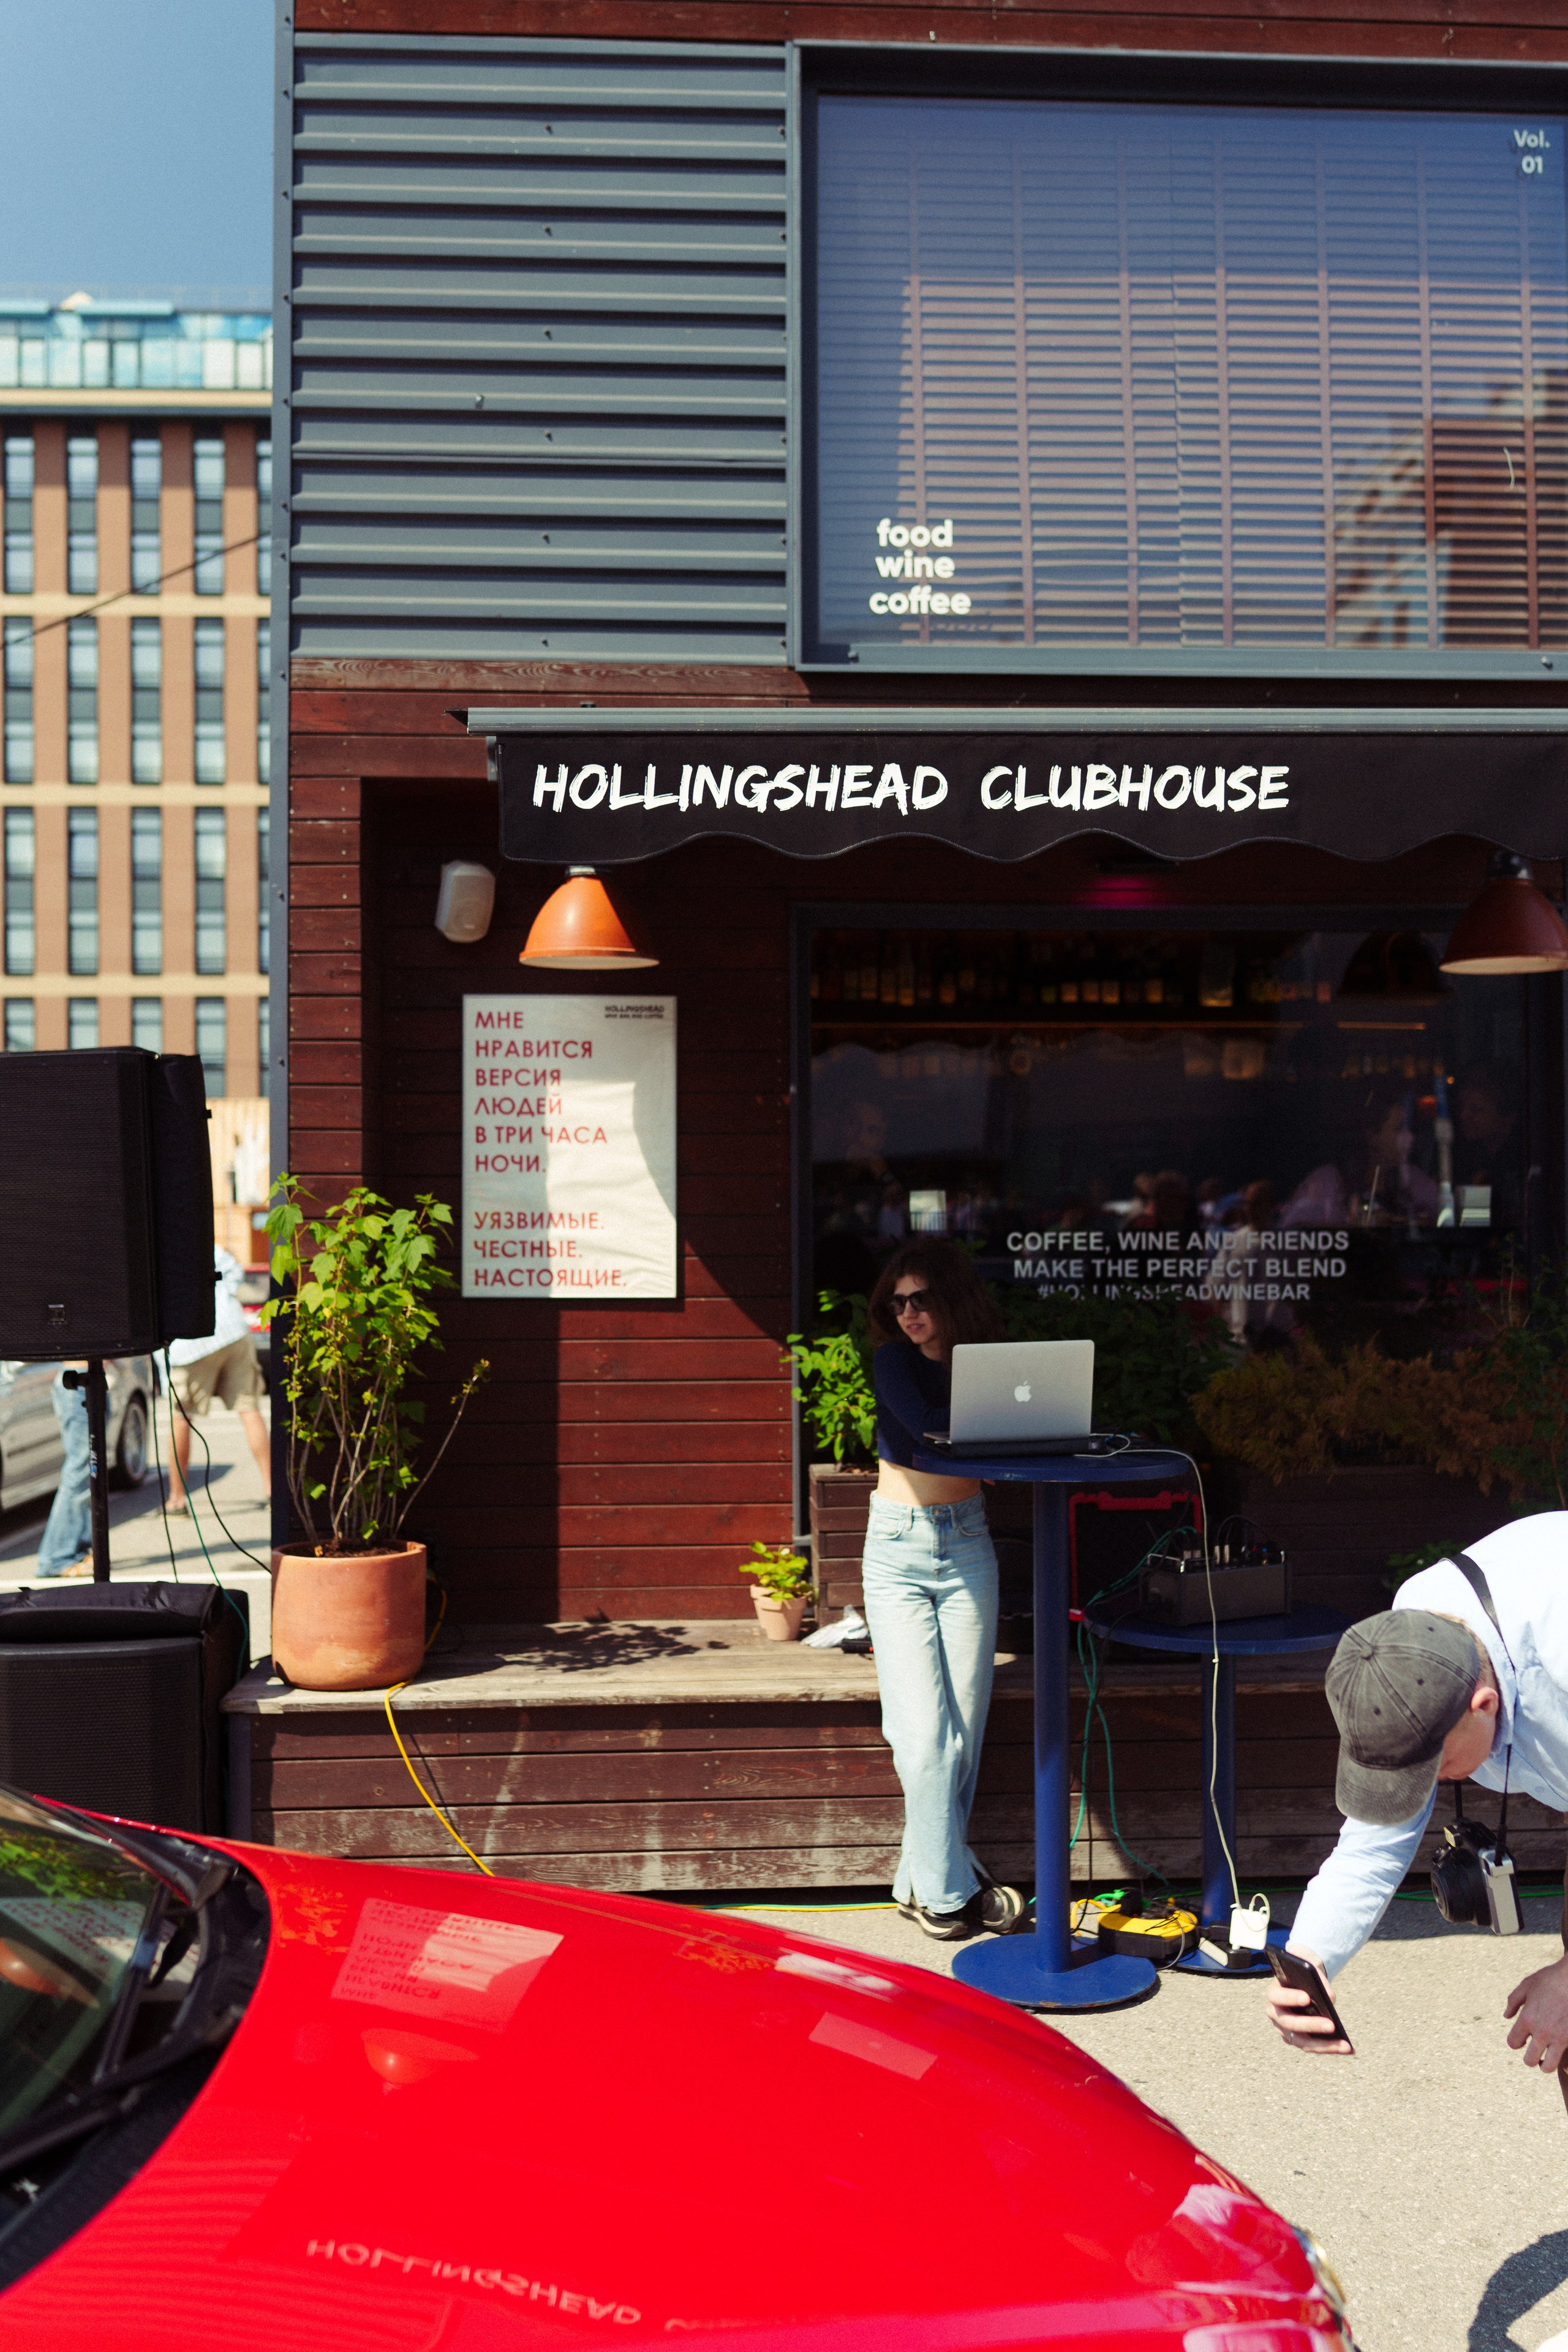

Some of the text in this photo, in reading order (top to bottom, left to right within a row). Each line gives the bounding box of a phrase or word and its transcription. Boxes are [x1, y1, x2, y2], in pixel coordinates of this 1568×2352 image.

[1513, 129, 1551, 148] Vol.
[1521, 155, 1543, 175] 01
[876, 518, 953, 548] food
[875, 548, 956, 579] wine
[869, 584, 971, 615] coffee
[532, 763, 1289, 816] HOLLINGSHEAD CLUBHOUSE
[475, 1011, 523, 1029] МНЕ
[475, 1040, 592, 1058] НРАВИТСЯ
[475, 1069, 561, 1087] ВЕРСИЯ
[475, 1093, 562, 1117] ЛЮДЕЙ
[475, 1126, 607, 1144] В ТРИ ЧАСА
[475, 1154, 547, 1173] НОЧИ.
[474, 1211, 605, 1229] УЯЗВИМЫЕ.
[473, 1240, 583, 1258] ЧЕСТНЫЕ.
[1006, 1231, 1349, 1255] COFFEE, WINE AND FRIENDS
[1014, 1258, 1346, 1278] MAKE THE PERFECT BLEND
[474, 1268, 627, 1288] НАСТОЯЩИЕ.
[1037, 1284, 1310, 1301] #OINSEADWINEBAR
